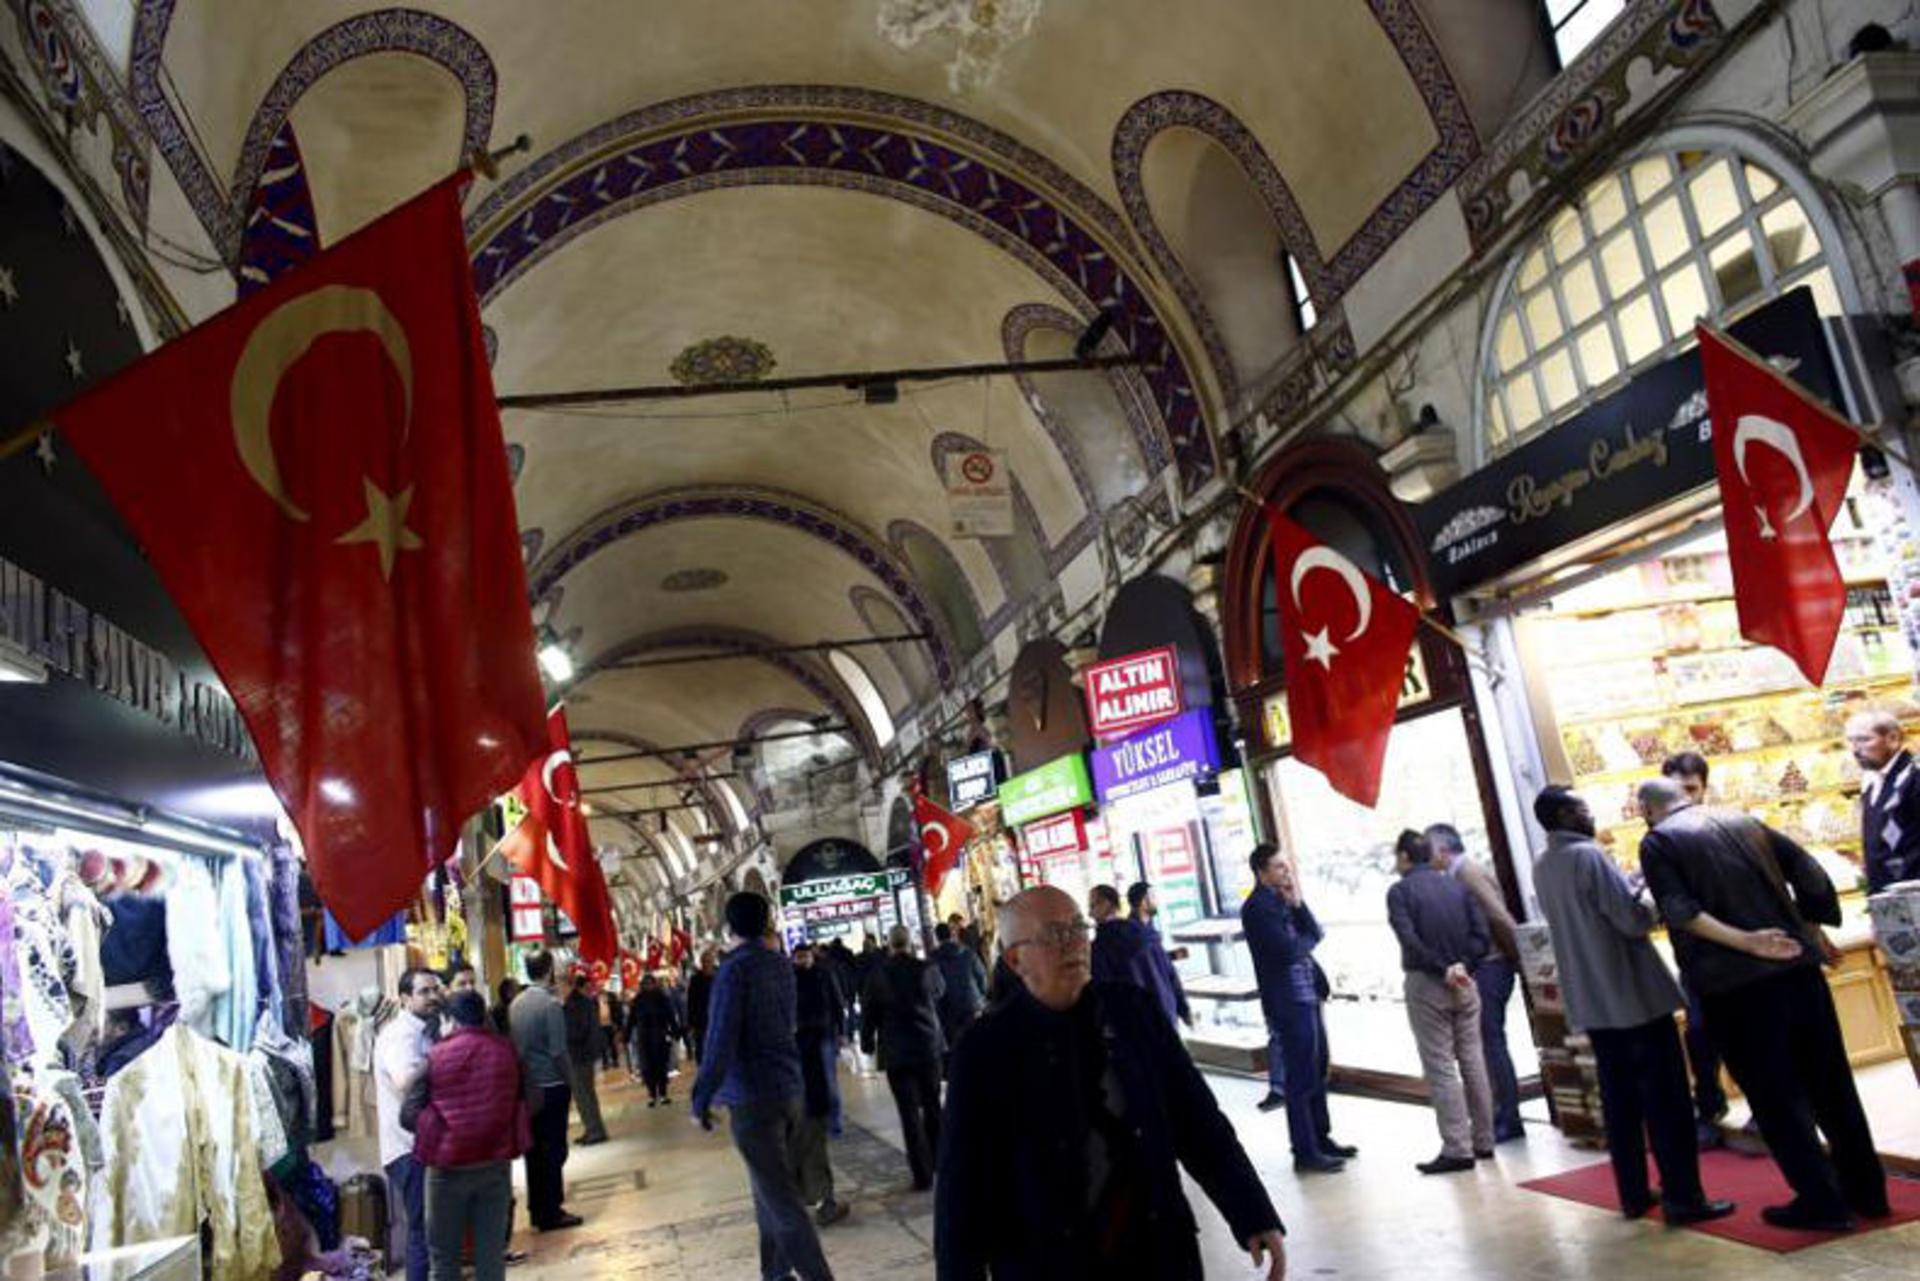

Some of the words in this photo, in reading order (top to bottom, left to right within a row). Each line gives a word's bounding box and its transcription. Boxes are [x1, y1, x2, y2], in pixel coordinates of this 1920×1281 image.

[1100, 659, 1164, 695] ALTIN
[1100, 687, 1174, 723] ALINIR
[1112, 729, 1180, 779] YÜKSEL
